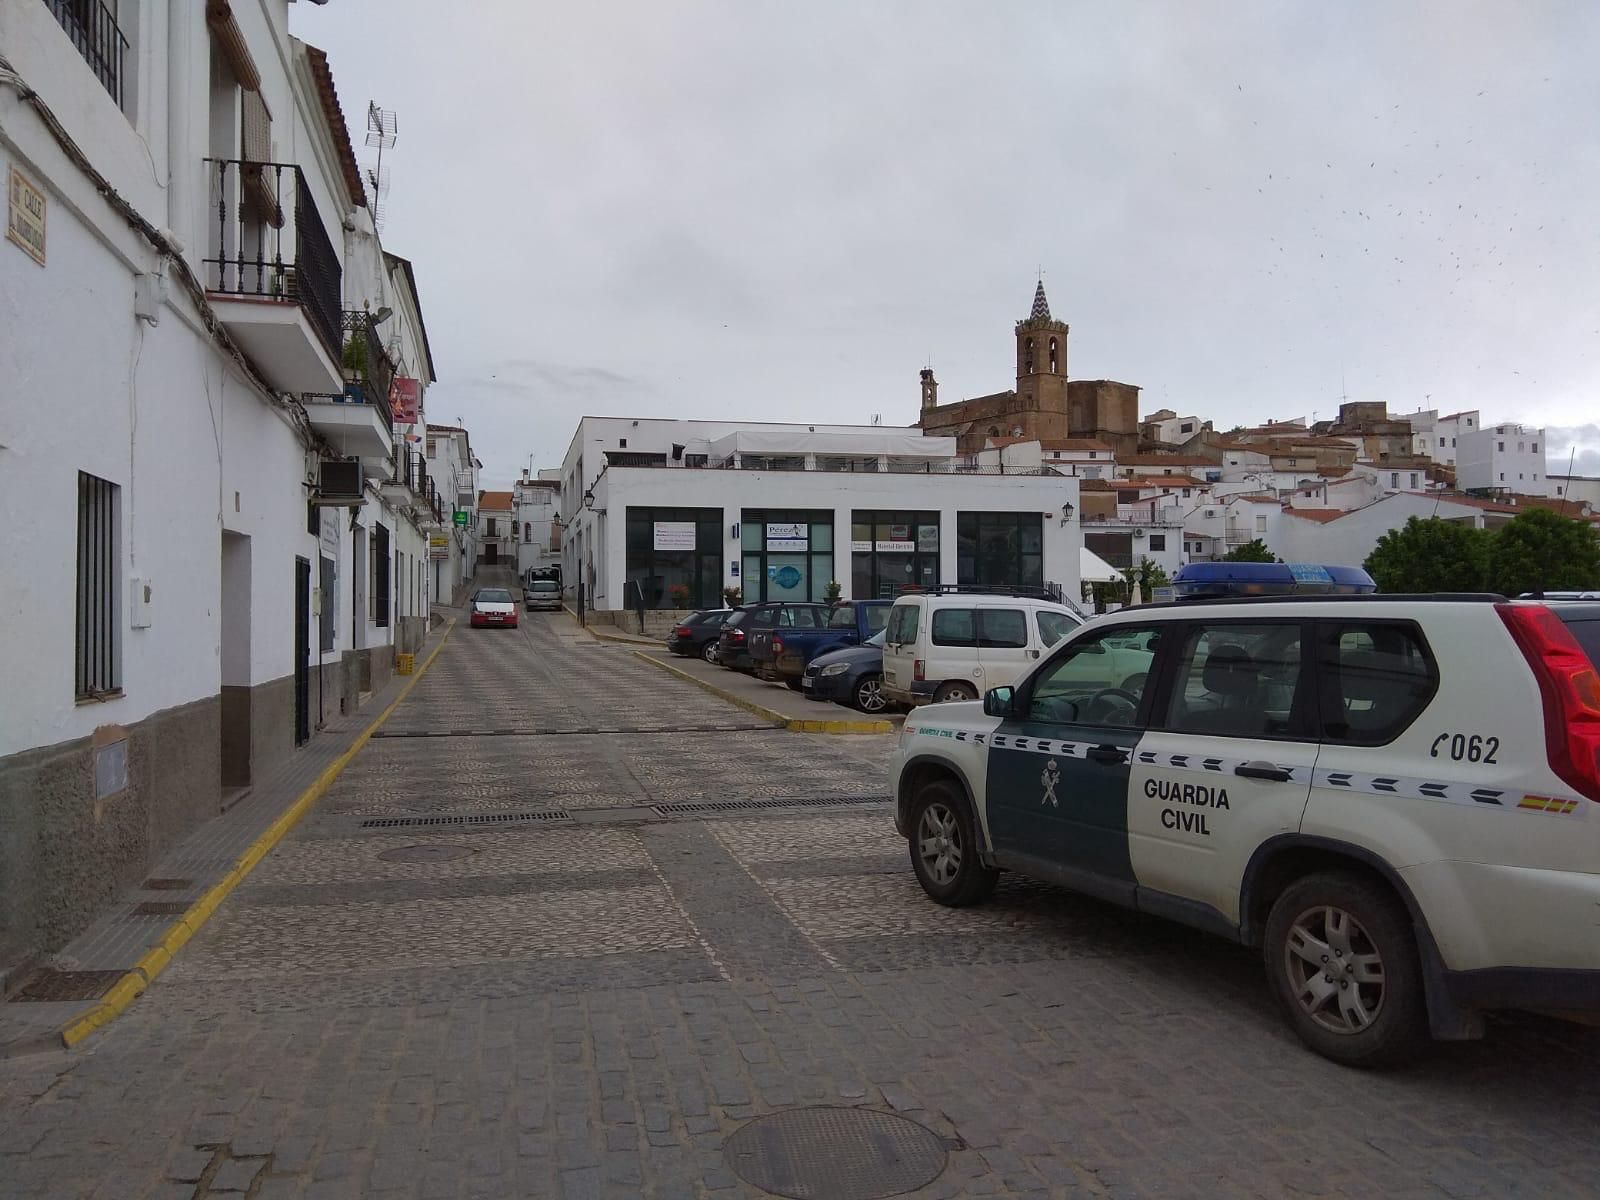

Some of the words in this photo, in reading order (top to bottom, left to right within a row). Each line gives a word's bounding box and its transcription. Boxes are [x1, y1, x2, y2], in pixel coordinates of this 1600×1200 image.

[1450, 734, 1500, 764] 062
[1144, 779, 1230, 810] GUARDIA
[1161, 809, 1210, 835] CIVIL
